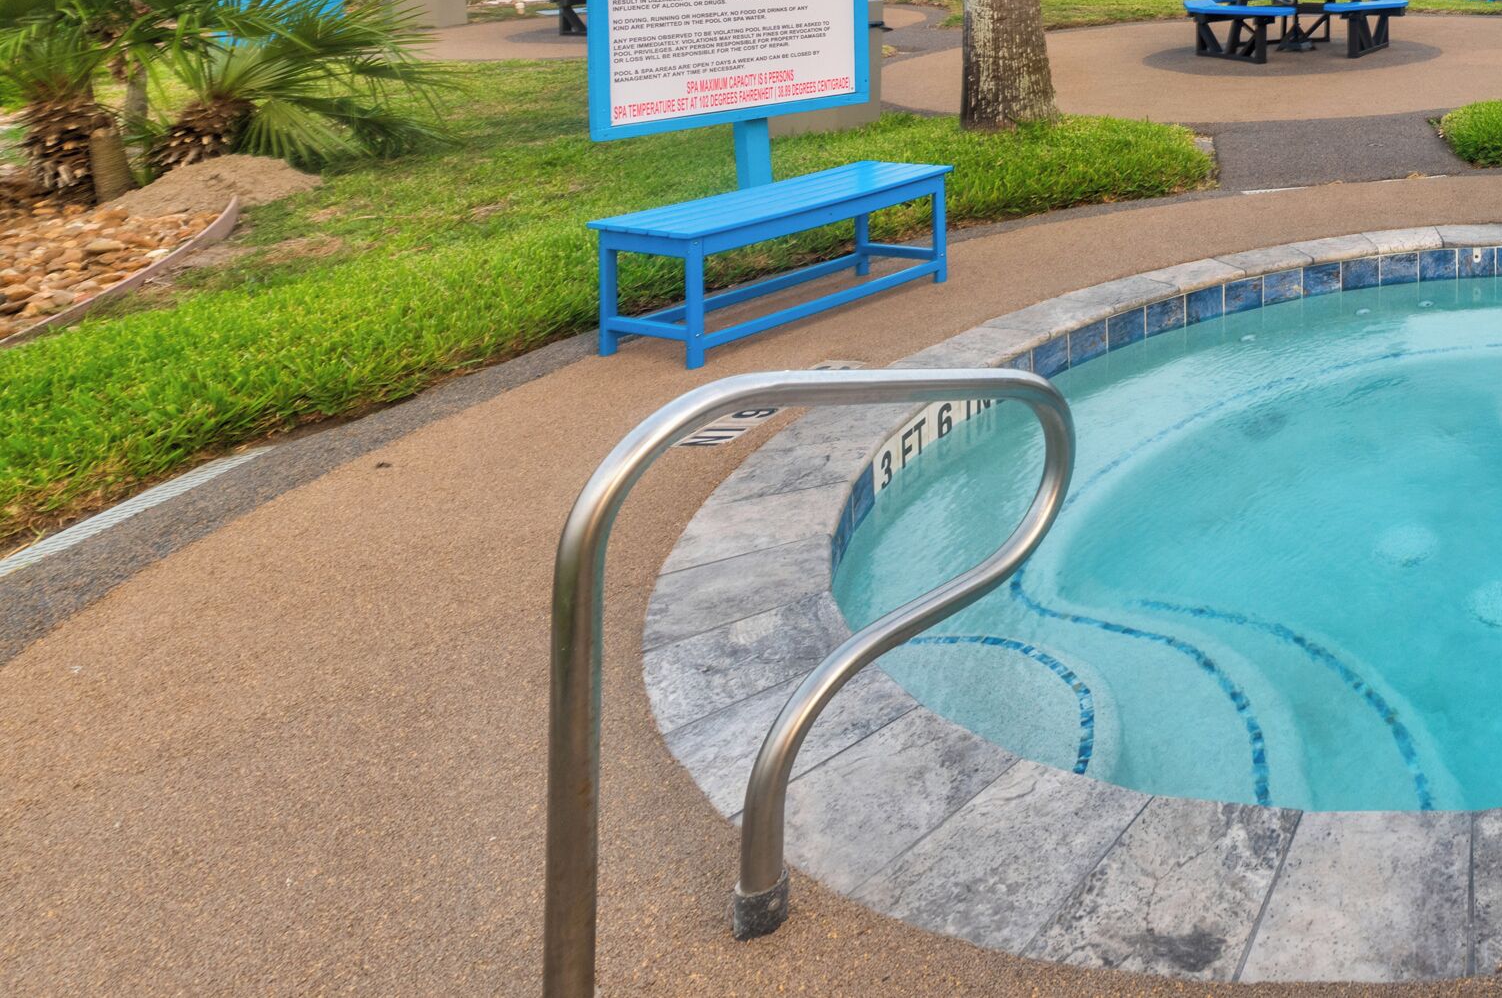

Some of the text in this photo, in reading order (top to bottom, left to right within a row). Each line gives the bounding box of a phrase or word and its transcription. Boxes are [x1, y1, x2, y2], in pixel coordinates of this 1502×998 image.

[613, 4, 650, 12] INFLUENCE
[662, 1, 692, 9] ALCOHOL
[658, 33, 693, 41] OBSERVED
[713, 28, 744, 36] VIOLATING
[687, 69, 794, 94] SPA MAXIMUM CAPACITY IS 6 PERSONS
[614, 106, 627, 120] SPA
[628, 99, 676, 118] TEMPERATURE
[677, 98, 689, 112] SET
[690, 96, 698, 110] AT
[710, 91, 738, 107] DEGREES
[739, 87, 774, 103] FAHRENHEIT
[792, 81, 816, 96] DEGREES
[680, 427, 747, 446] IN
[881, 450, 893, 490] 3
[902, 417, 926, 470] FT
[938, 402, 952, 439] 6
